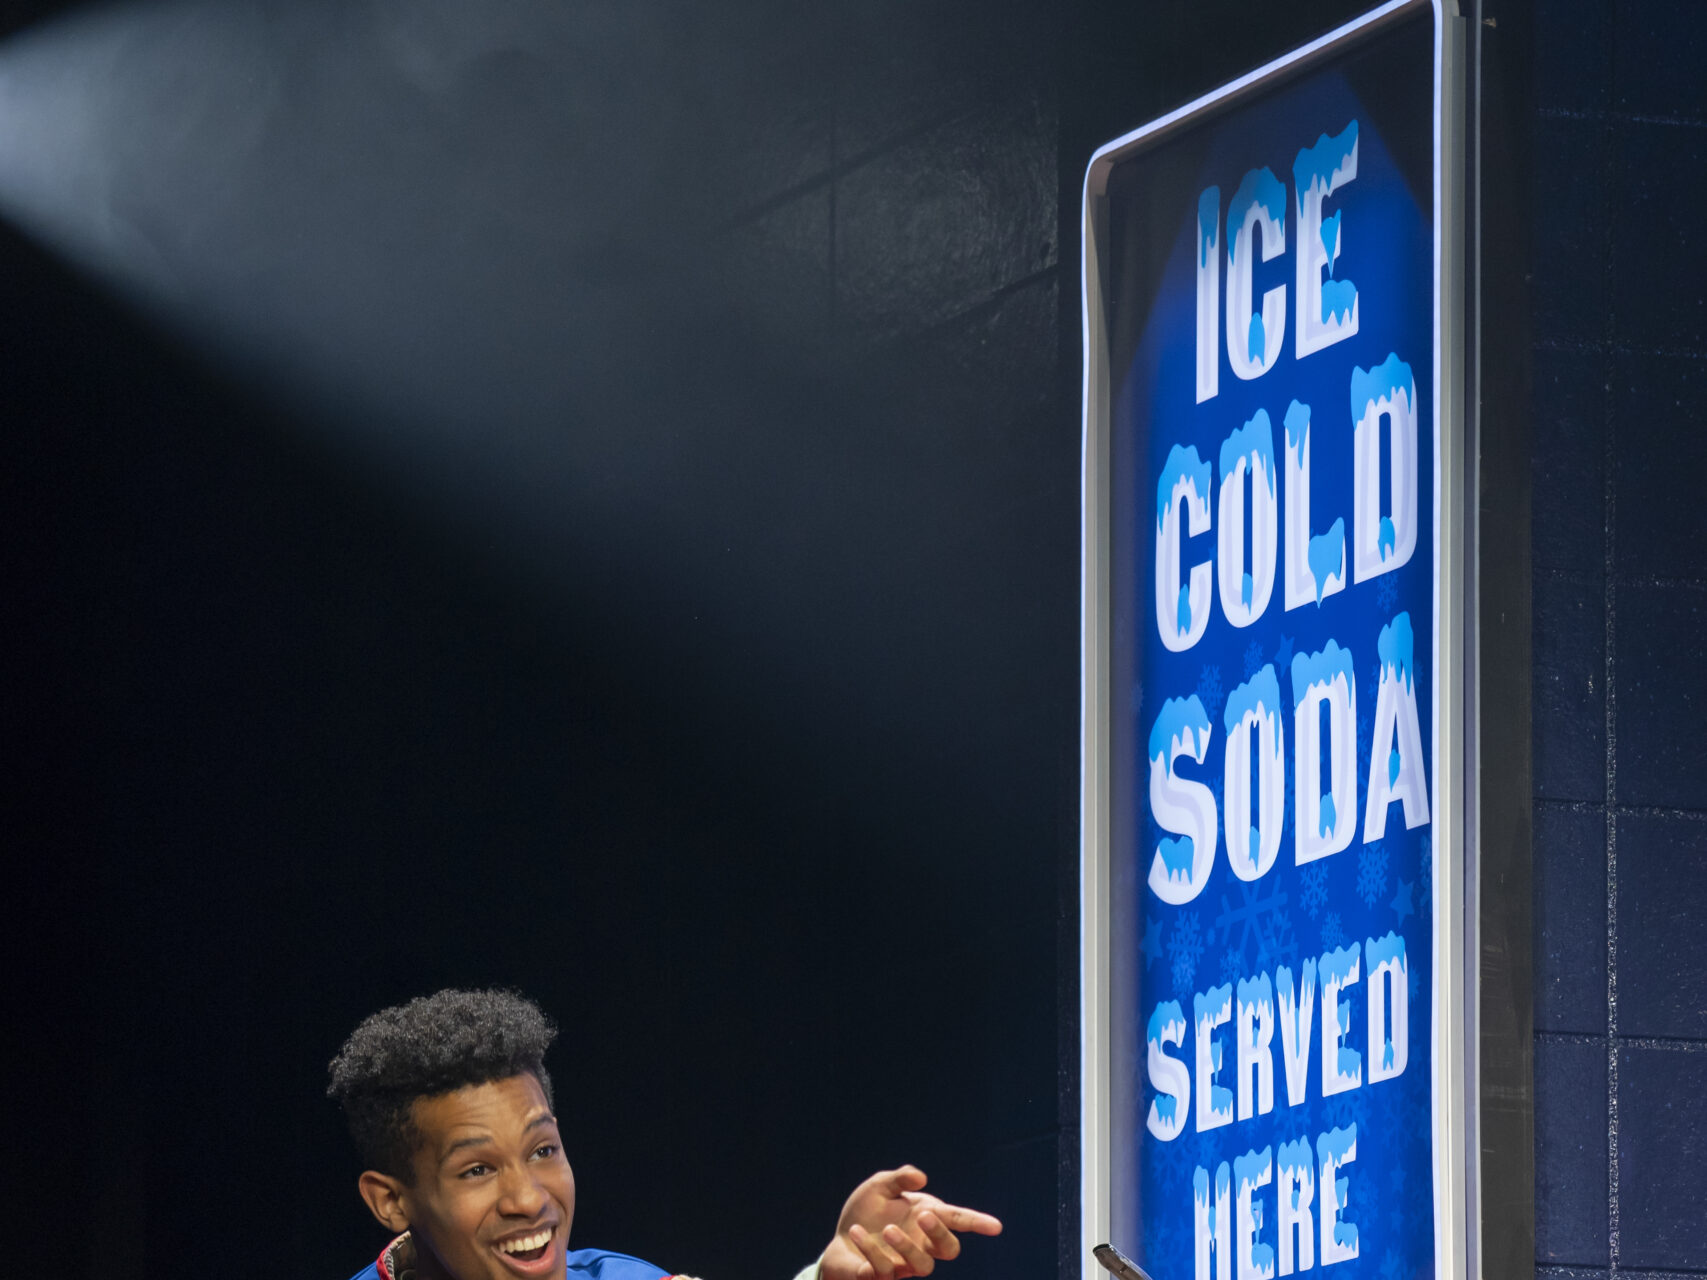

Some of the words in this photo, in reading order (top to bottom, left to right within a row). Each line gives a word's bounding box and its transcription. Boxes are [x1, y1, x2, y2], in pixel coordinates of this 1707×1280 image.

[1196, 119, 1359, 405] ICE
[1155, 352, 1417, 652] COLD
[1147, 611, 1431, 905] SODA
[1146, 930, 1409, 1142] SERVED
